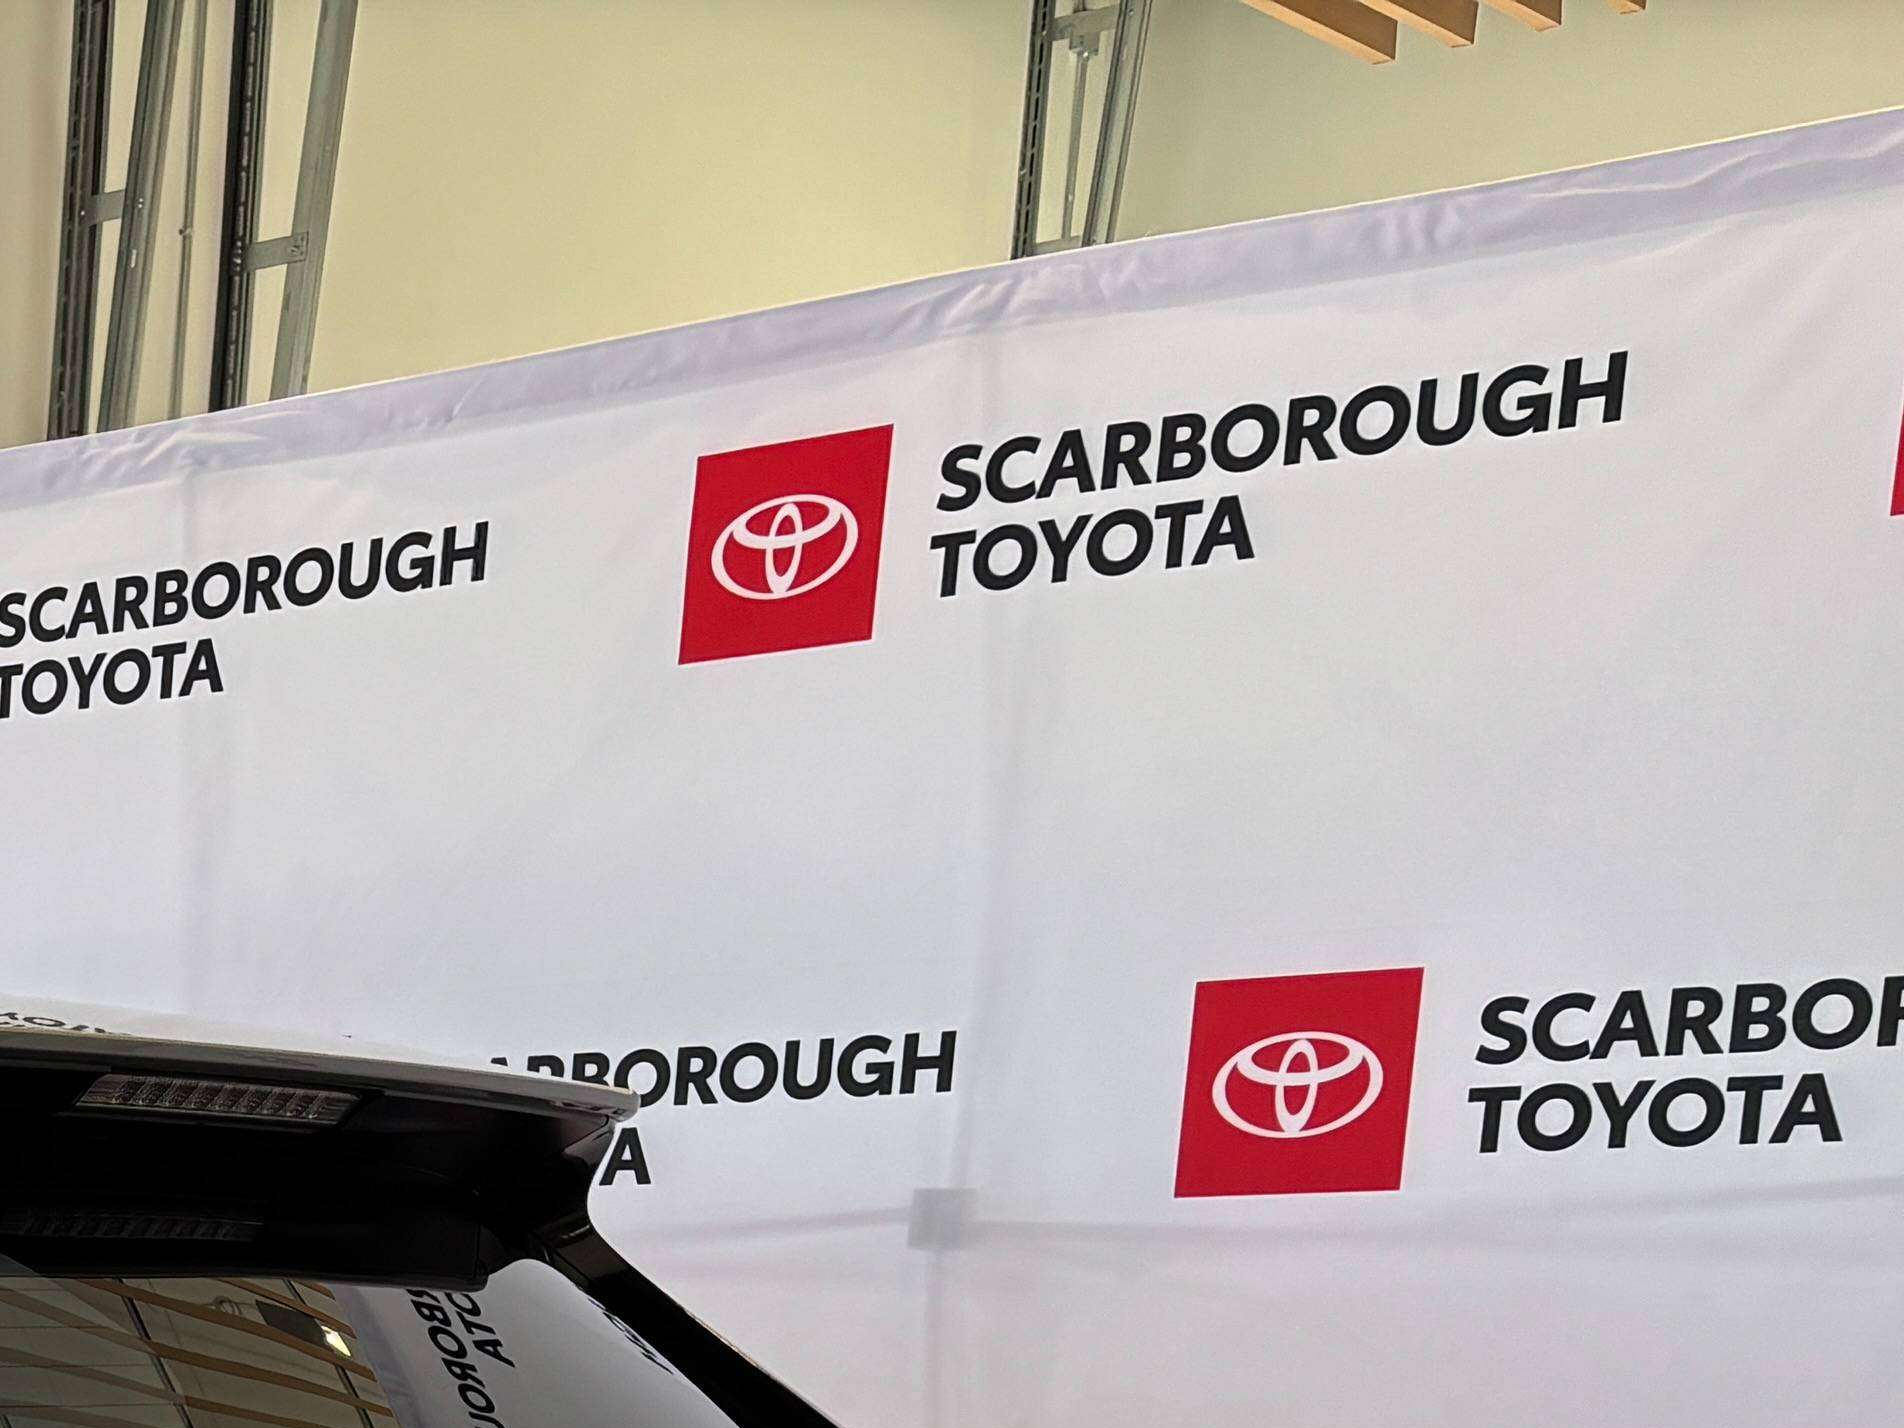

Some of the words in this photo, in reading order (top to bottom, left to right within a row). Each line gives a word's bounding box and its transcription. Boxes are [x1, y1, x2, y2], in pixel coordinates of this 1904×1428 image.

[936, 350, 1629, 512] SCARBOROUGH
[930, 495, 1255, 598] TOYOTA
[1467, 1073, 1843, 1154] TOYOTA
